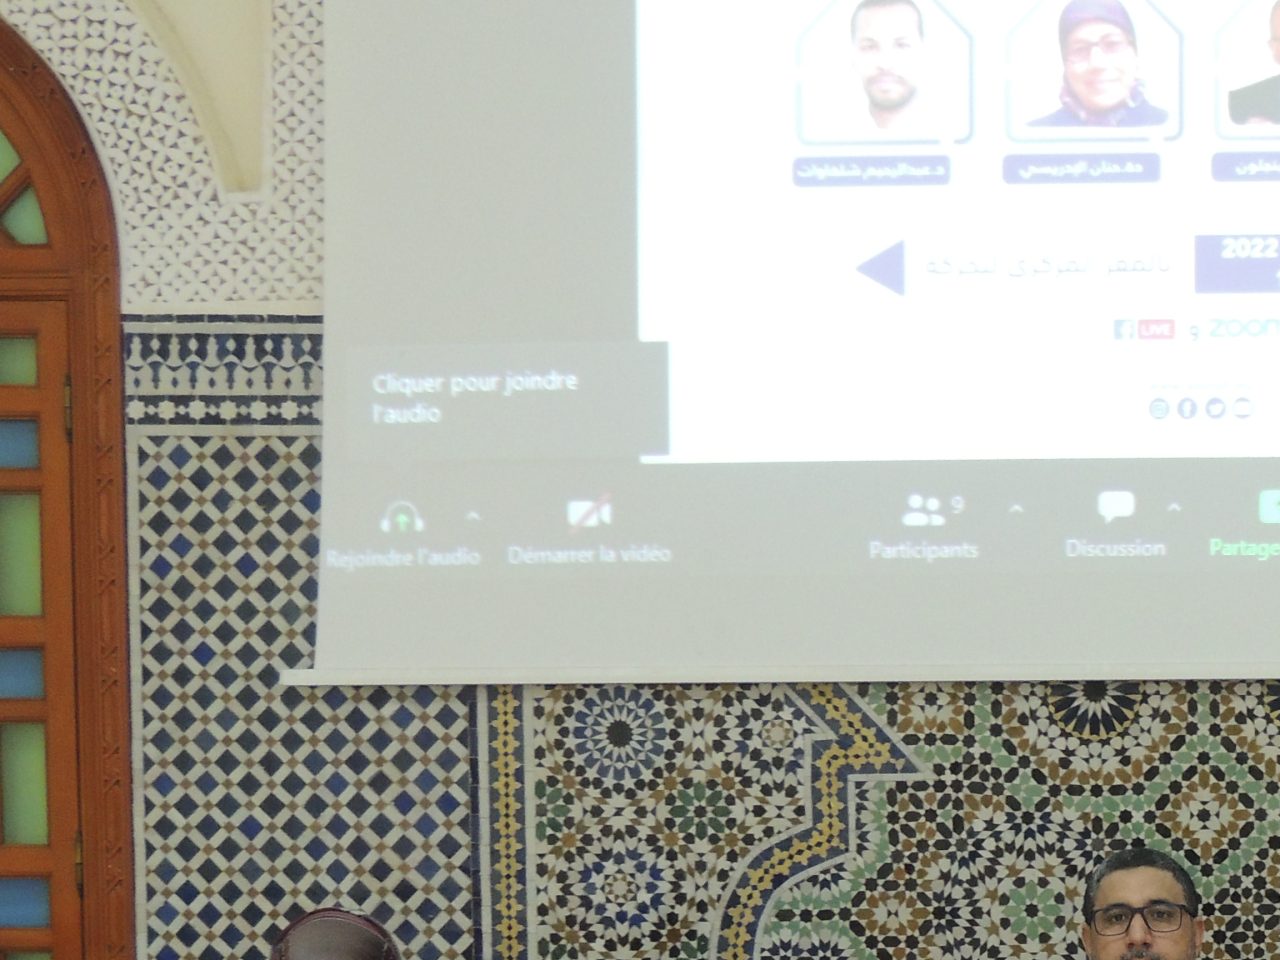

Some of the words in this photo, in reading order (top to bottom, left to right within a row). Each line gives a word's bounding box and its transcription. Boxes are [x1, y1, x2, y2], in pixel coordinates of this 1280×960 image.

[1220, 237, 1279, 259] 2022
[1140, 323, 1172, 337] LIVE
[372, 373, 445, 397] Cliquer
[450, 375, 501, 398] pour
[503, 369, 579, 397] joindre
[371, 402, 442, 424] l'audio
[950, 495, 965, 514] 9
[325, 547, 413, 572] Rejoindre
[417, 545, 481, 567] l'audio
[507, 545, 593, 566] Démarrer
[599, 545, 617, 564] la
[620, 543, 673, 564] vidéo
[868, 540, 980, 563] Participants
[1065, 538, 1167, 558] Discussion
